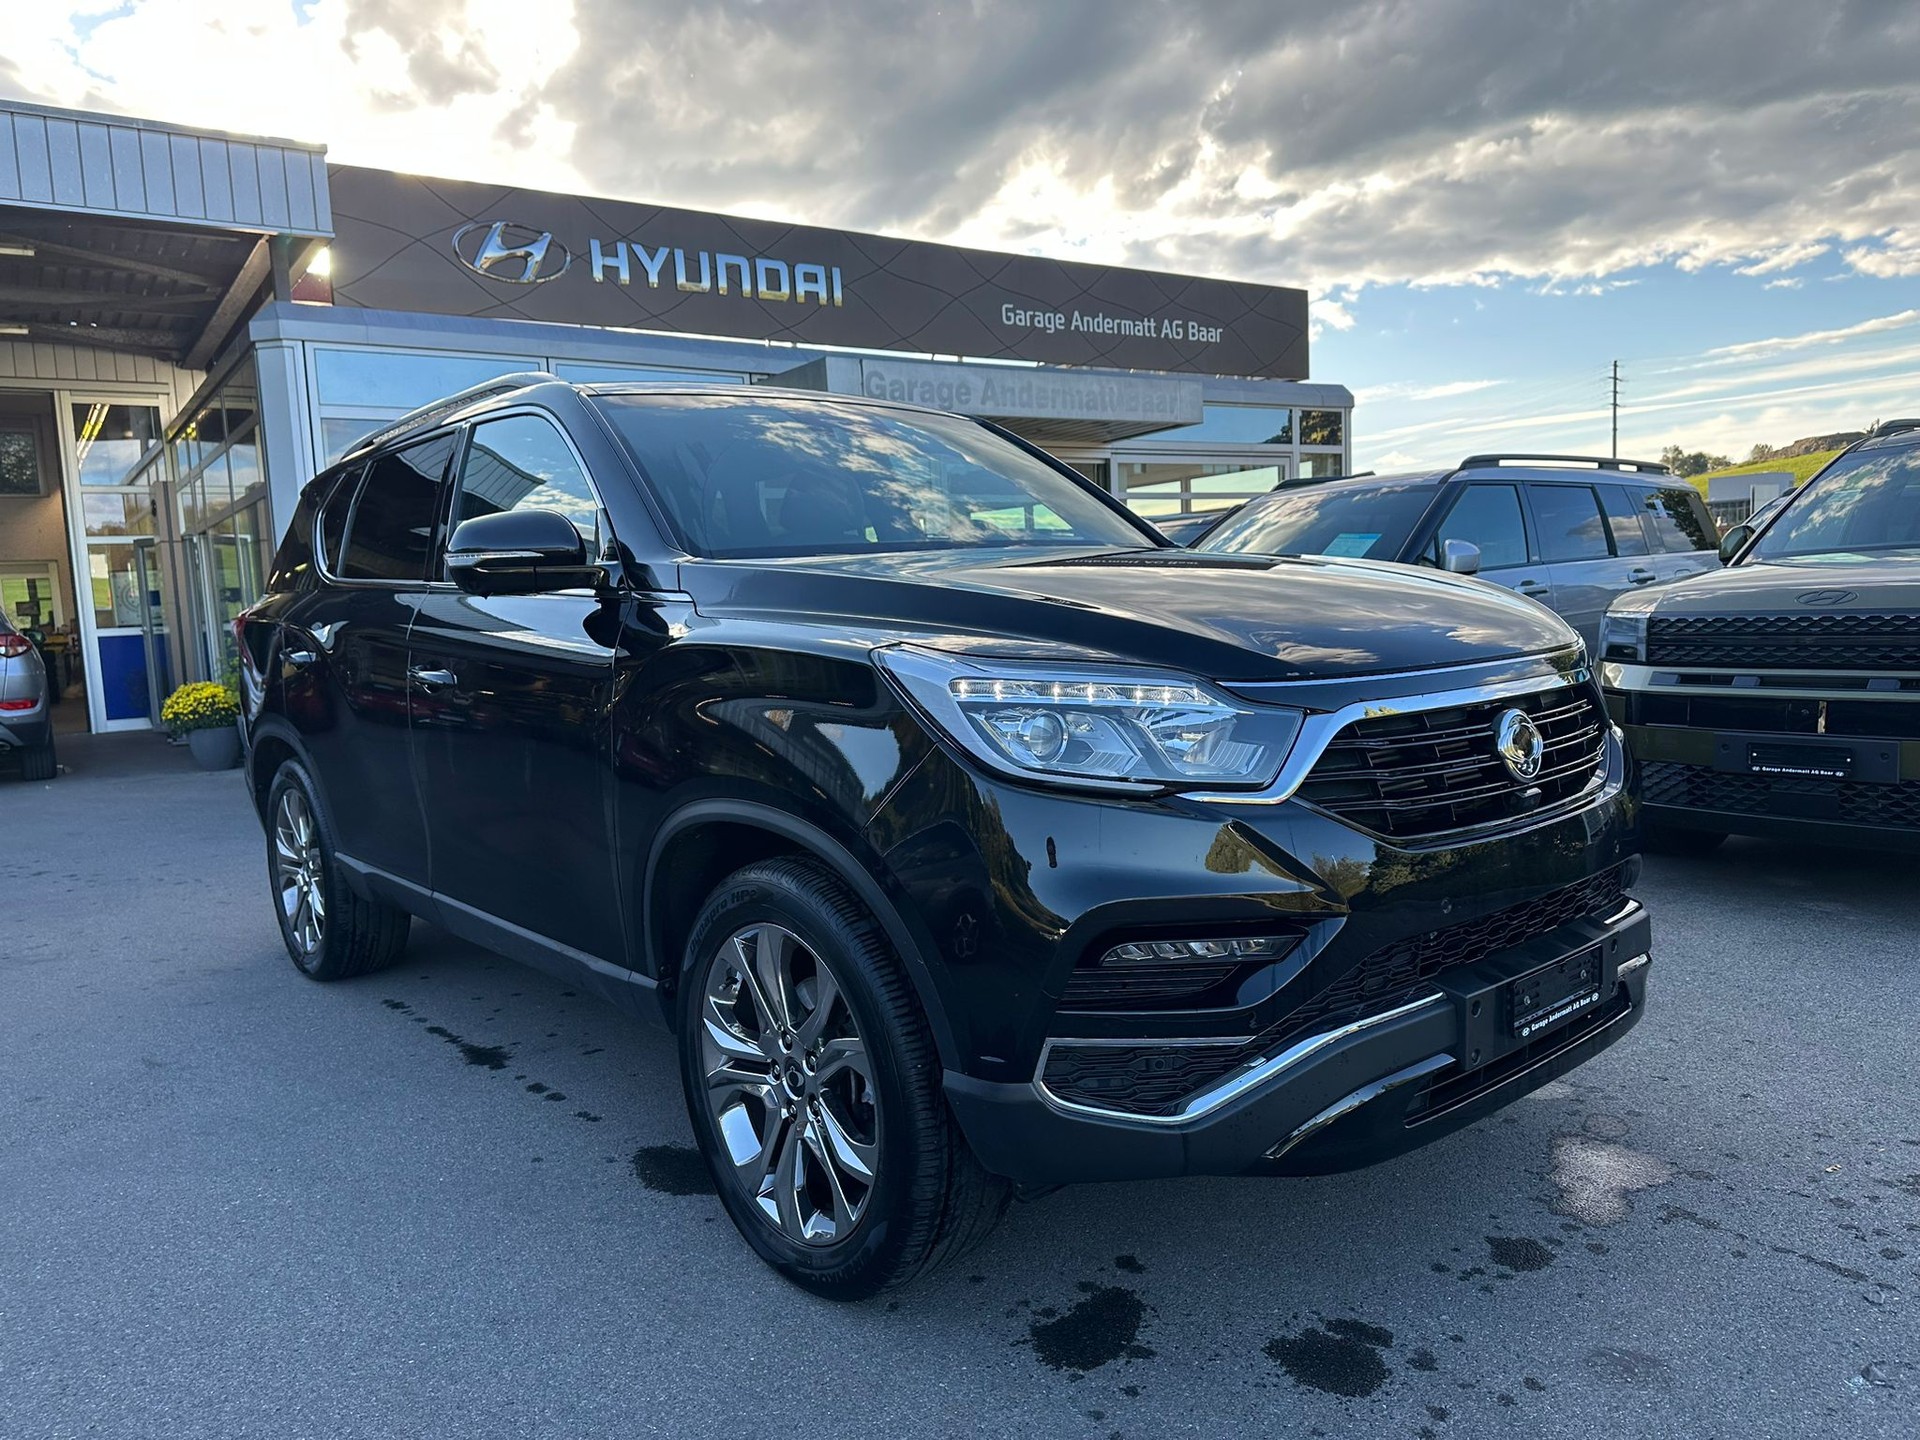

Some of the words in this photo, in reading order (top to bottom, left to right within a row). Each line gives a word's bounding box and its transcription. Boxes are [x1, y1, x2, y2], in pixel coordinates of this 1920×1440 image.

[589, 239, 843, 307] HYUNDAI
[1001, 304, 1066, 333] Garage
[1070, 310, 1157, 338] Andermatt
[1161, 319, 1184, 340] AG
[1188, 321, 1223, 343] Baar
[865, 370, 972, 411] Garage
[1531, 1019, 1548, 1031] Garage
[1549, 1005, 1573, 1022] Andermatt
[1573, 1001, 1580, 1010] AG
[1580, 997, 1591, 1006] Baar
